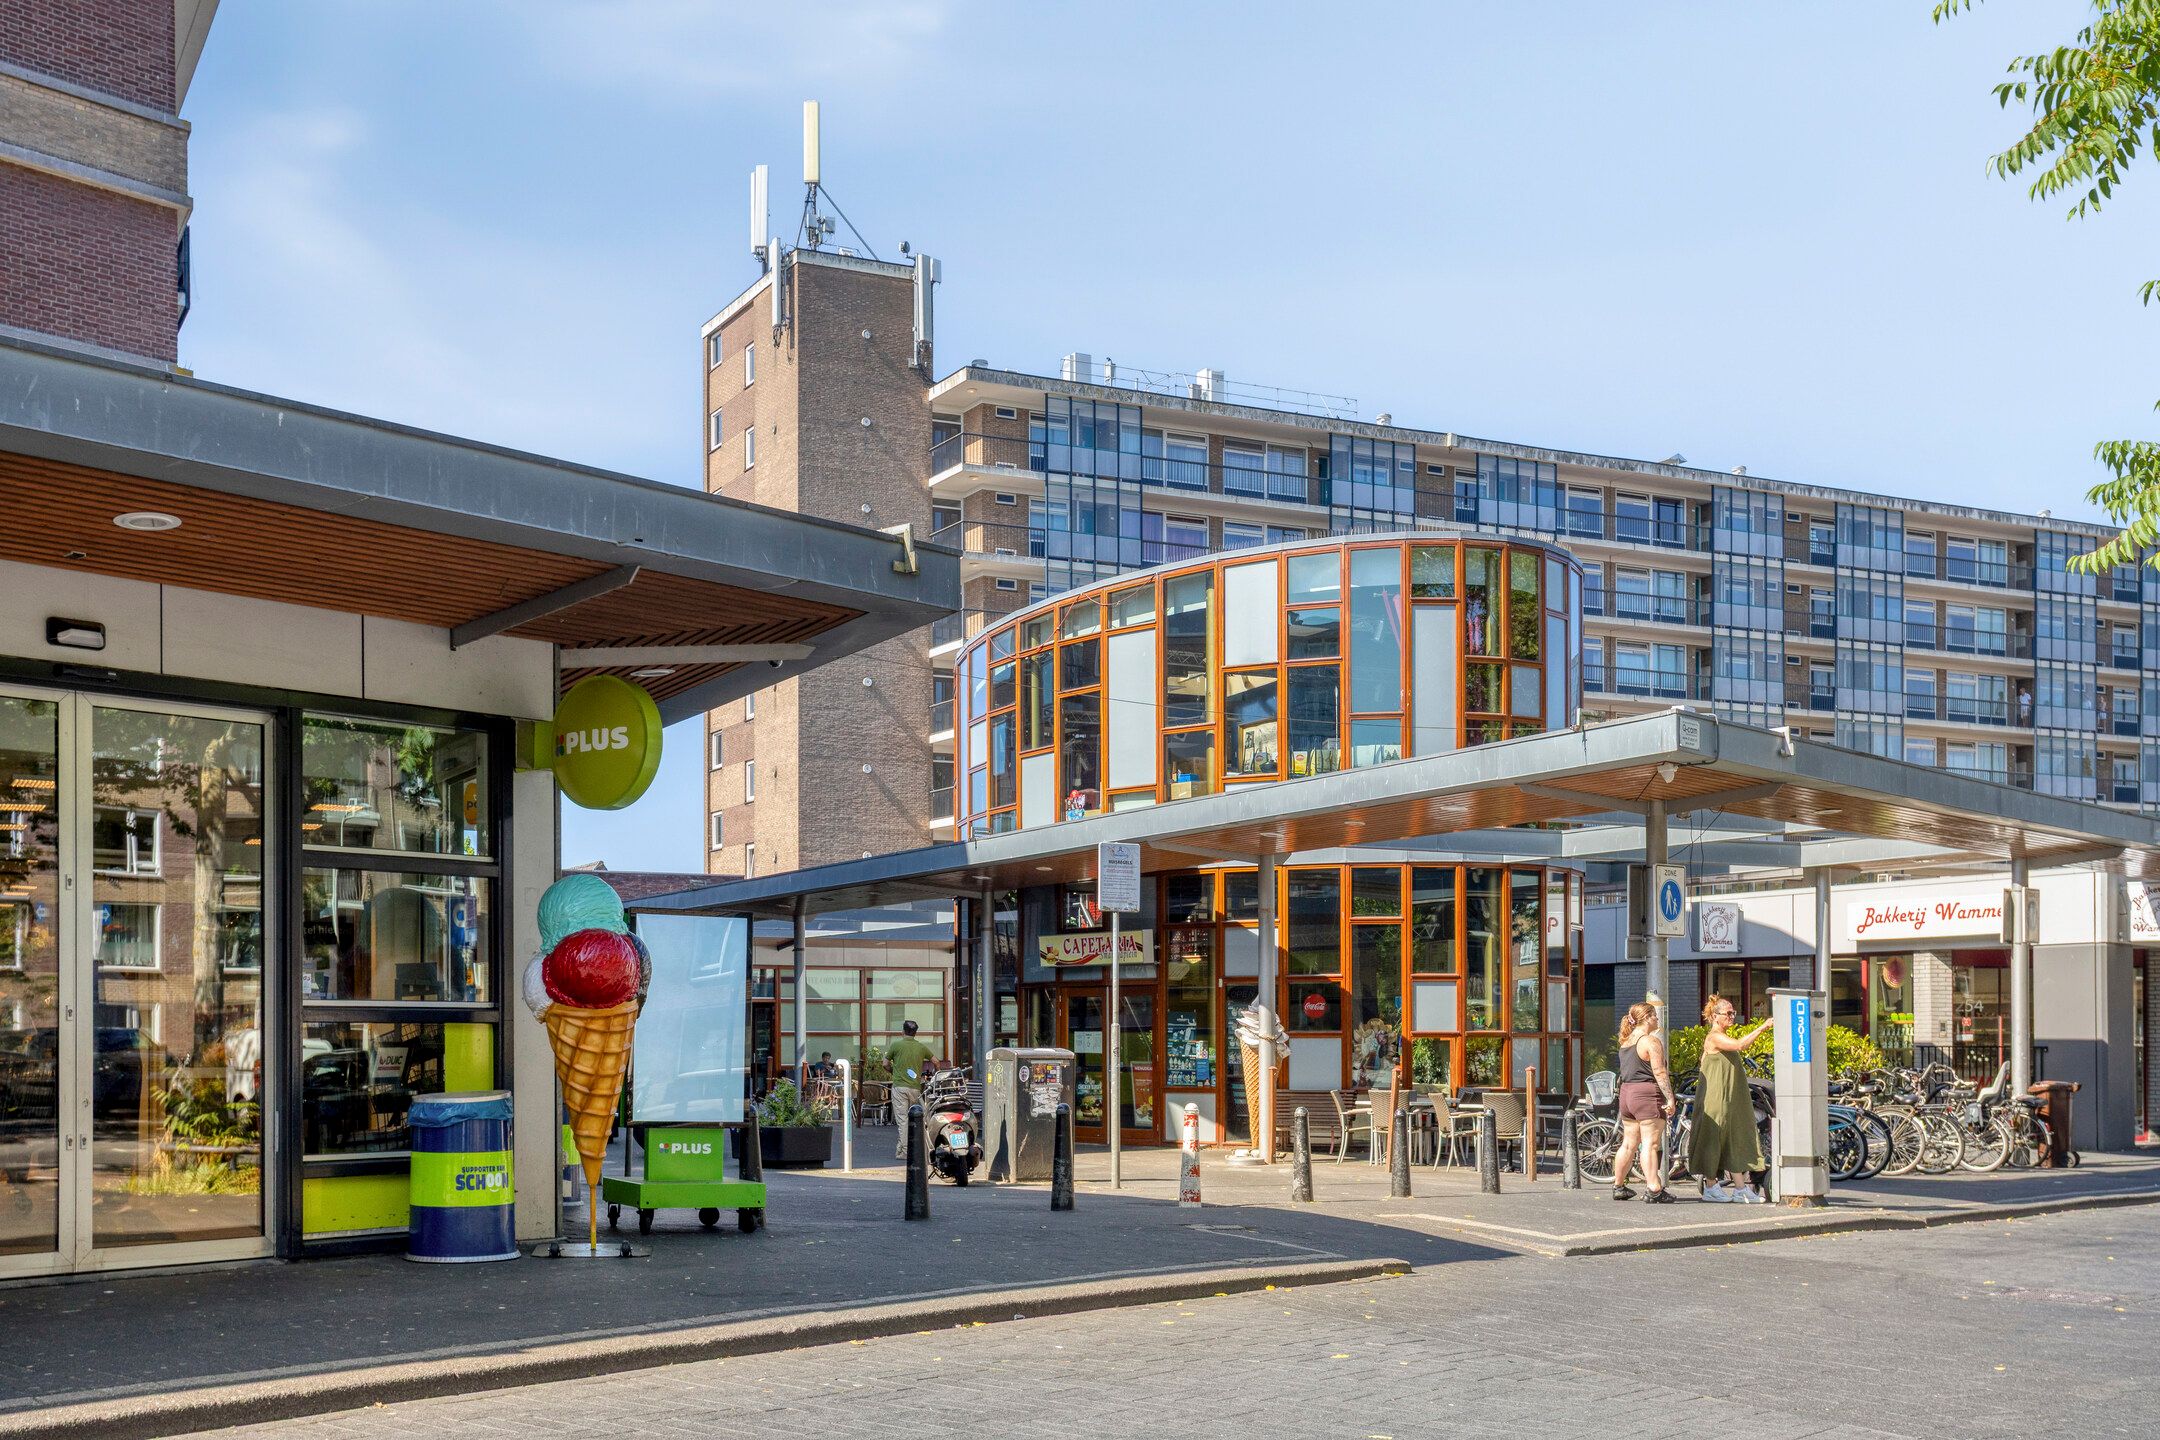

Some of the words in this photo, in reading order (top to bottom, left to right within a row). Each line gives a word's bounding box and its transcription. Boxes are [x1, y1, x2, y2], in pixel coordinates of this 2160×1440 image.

[566, 727, 629, 754] PLUS
[1664, 869, 1677, 877] ZONE
[1856, 906, 1927, 934] Bakkerij
[1935, 902, 2002, 921] Wamme
[1797, 1016, 1805, 1061] 30163
[671, 1143, 711, 1154] PLUS
[455, 1173, 508, 1191] SCHOON
